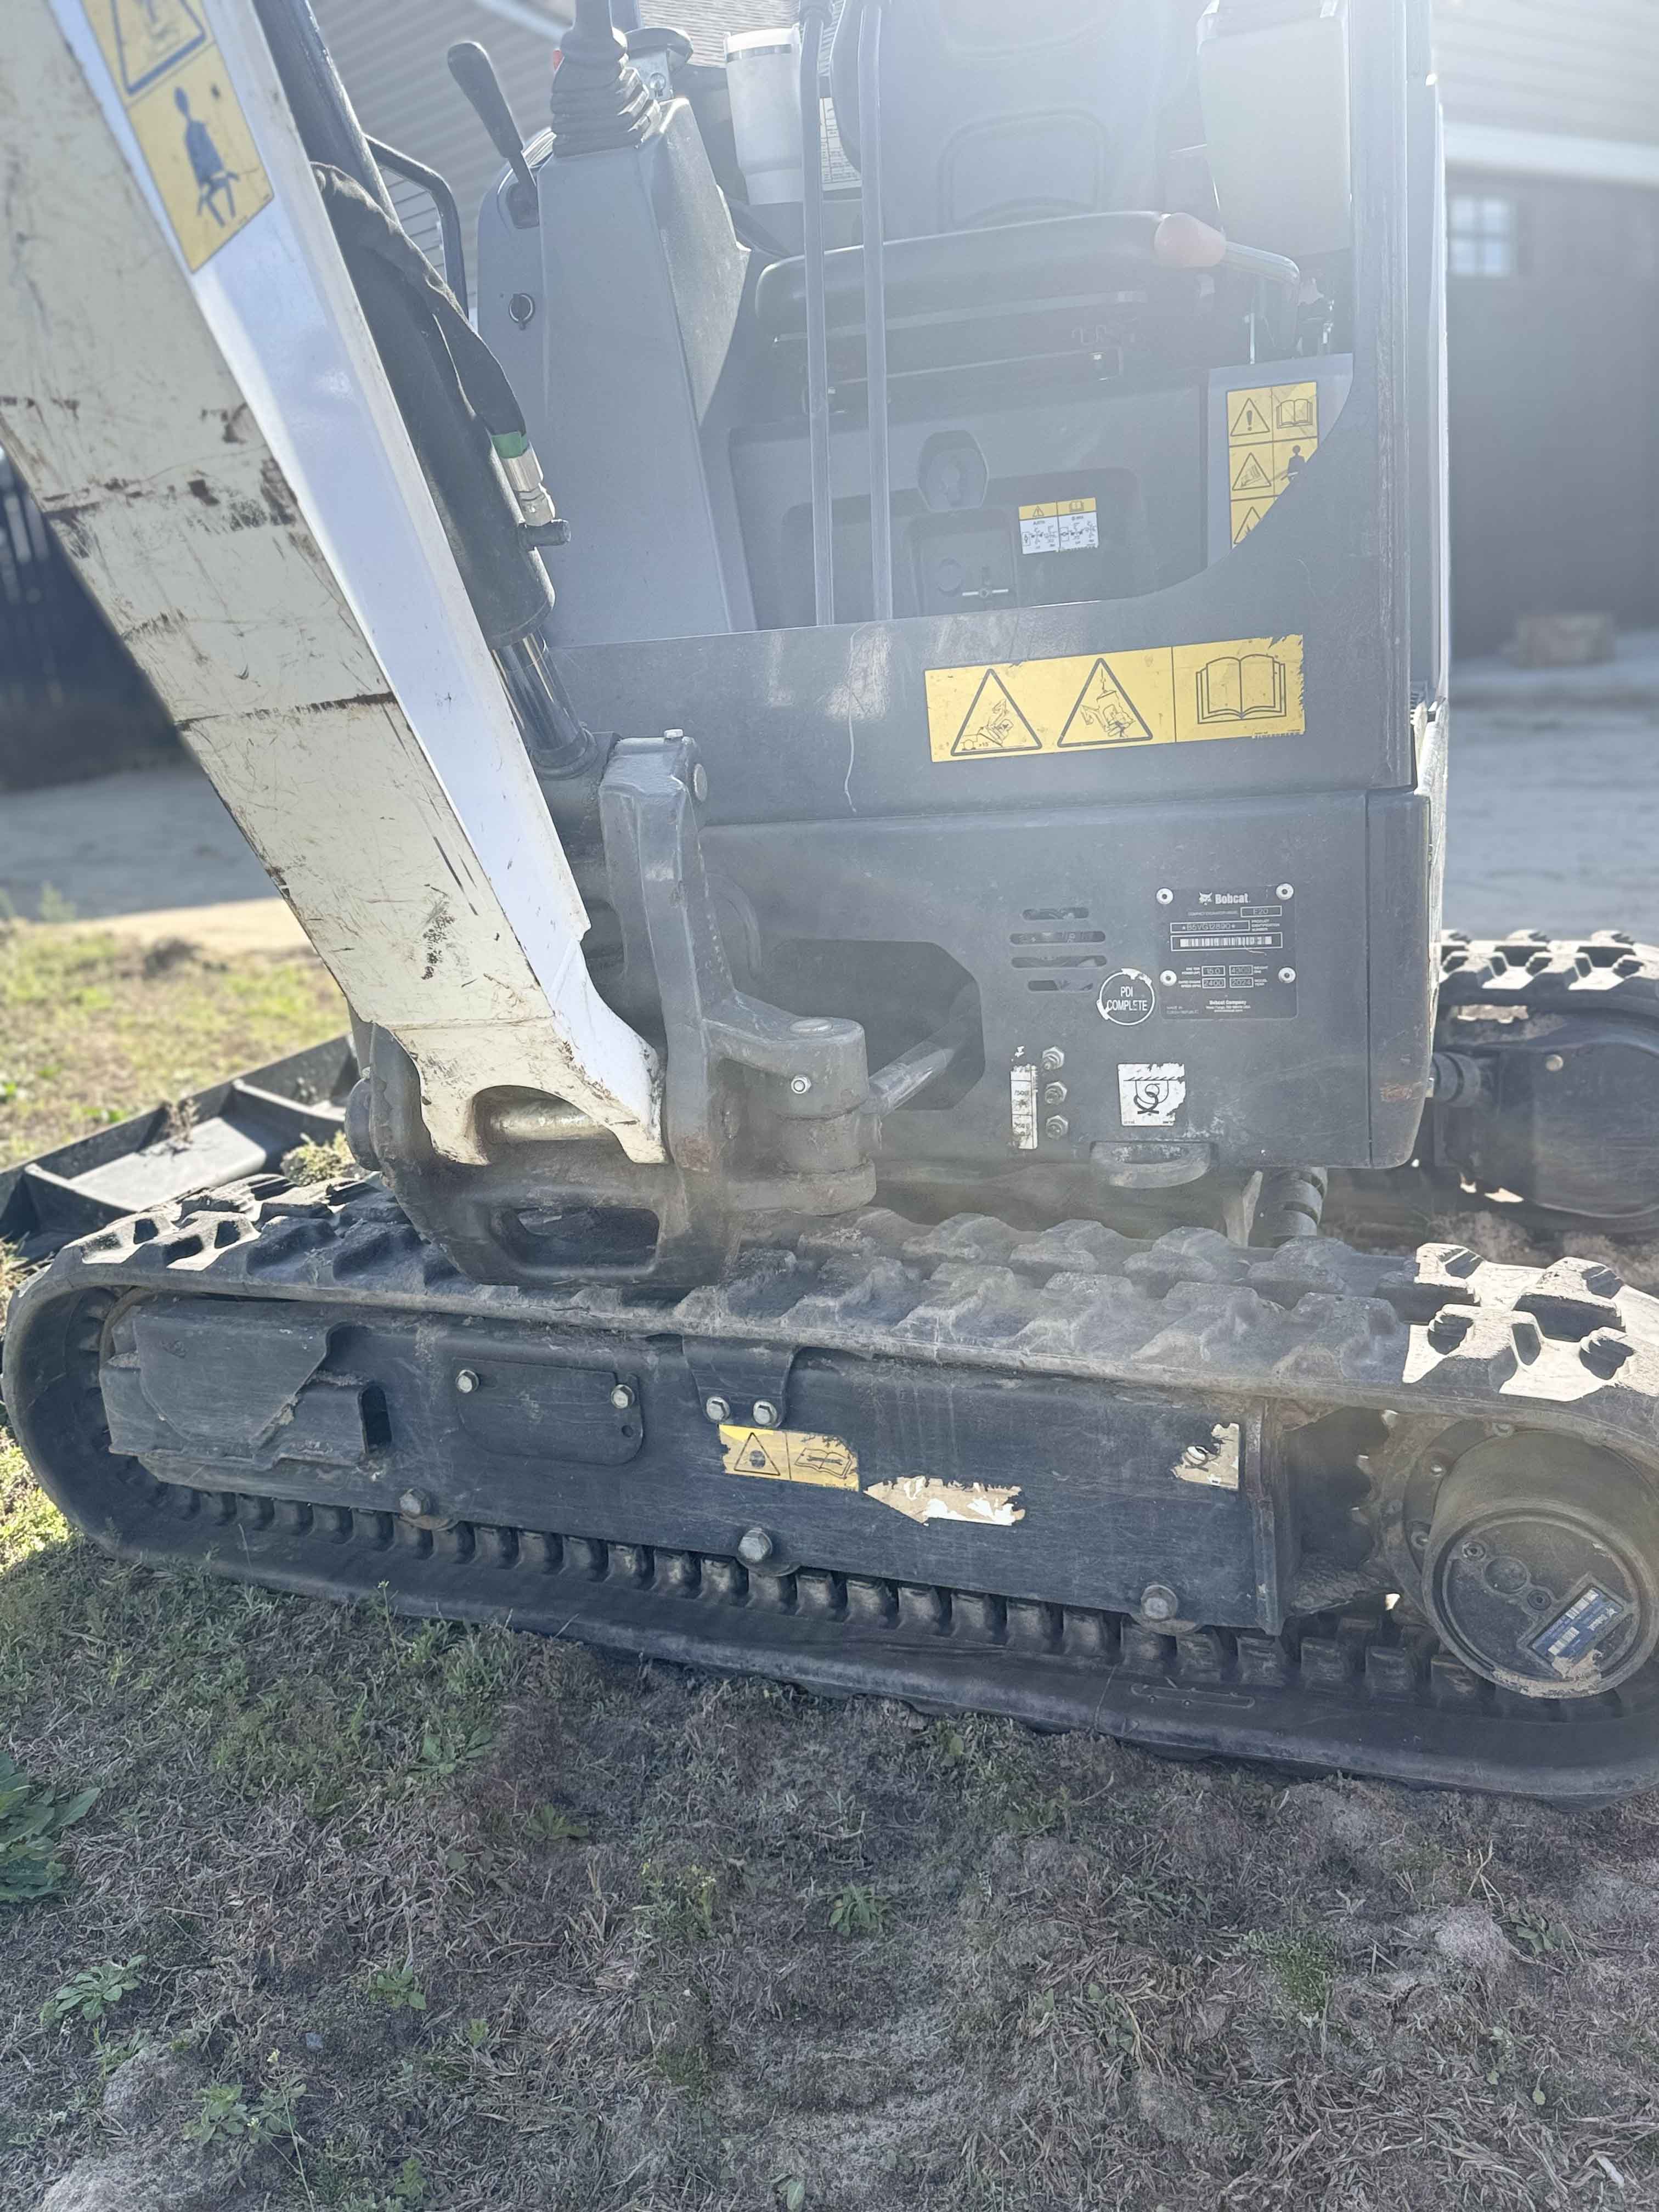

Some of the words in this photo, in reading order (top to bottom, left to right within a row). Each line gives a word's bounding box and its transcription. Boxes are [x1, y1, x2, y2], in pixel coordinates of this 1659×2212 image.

[1215, 893, 1249, 904] Bobcat
[1120, 986, 1133, 997] PDI
[1107, 1000, 1148, 1011] COMPLETE
